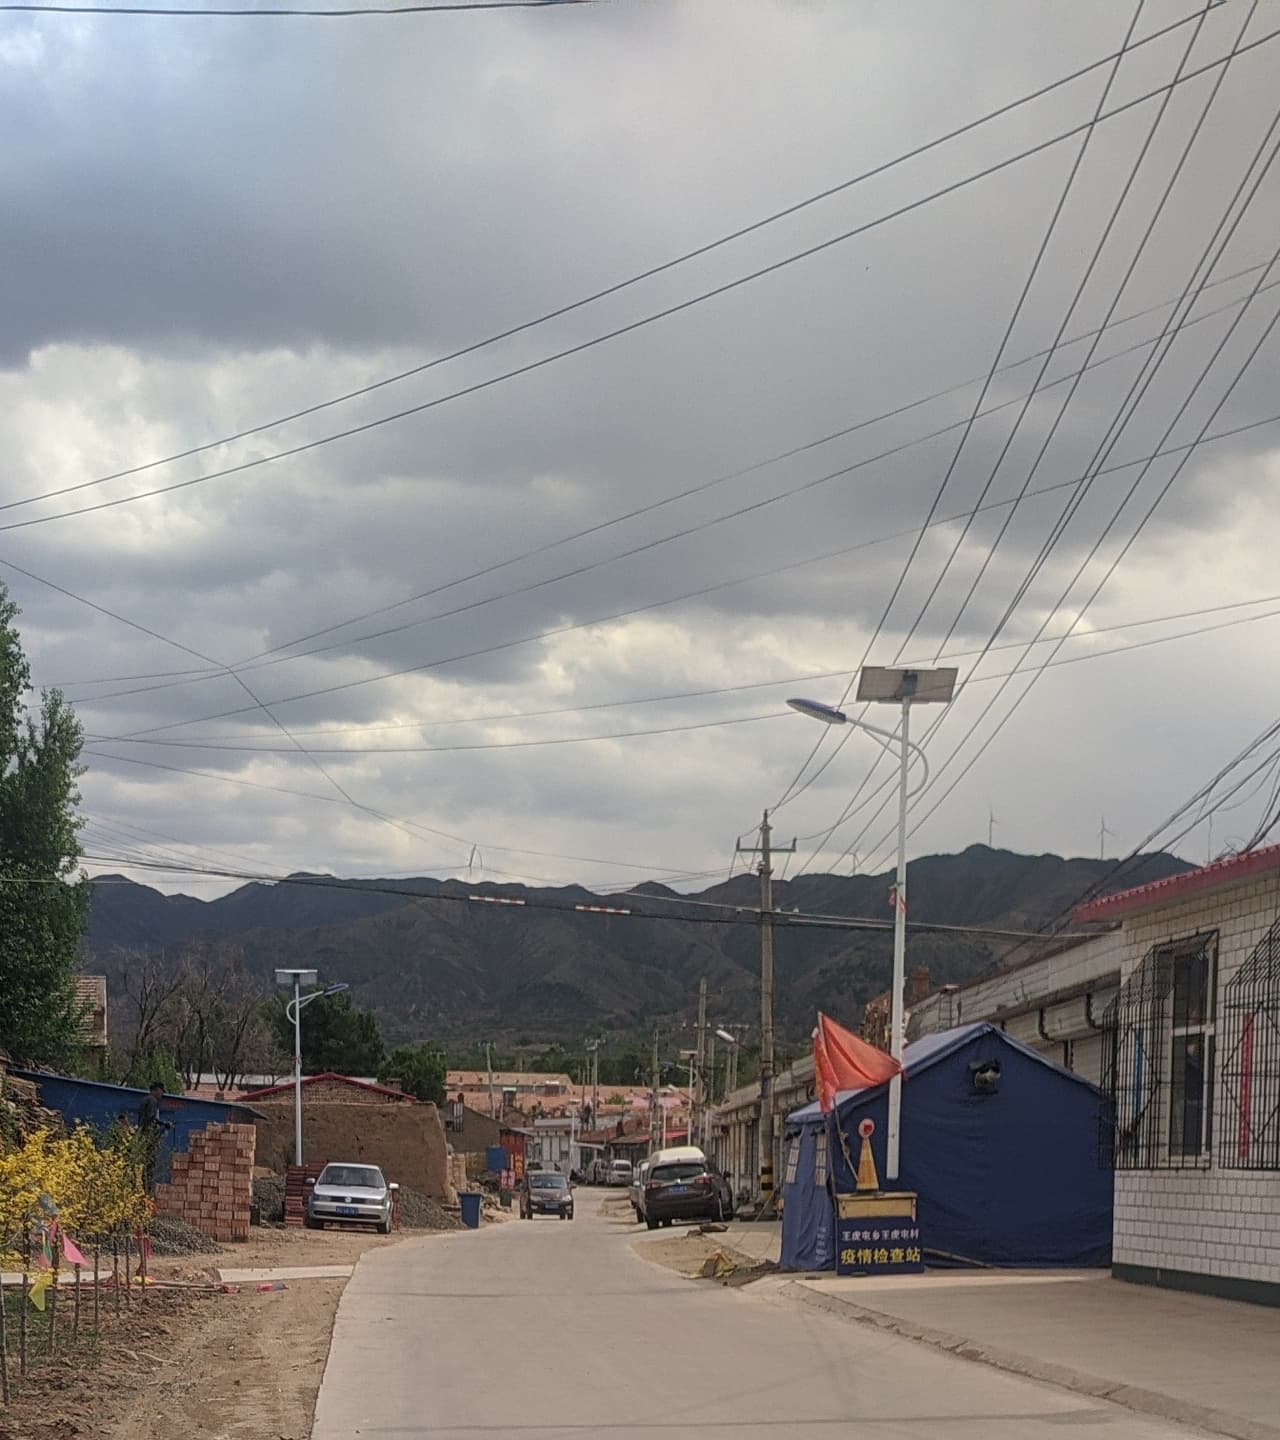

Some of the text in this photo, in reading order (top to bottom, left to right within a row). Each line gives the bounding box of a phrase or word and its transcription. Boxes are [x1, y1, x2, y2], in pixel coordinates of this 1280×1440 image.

[840, 1247, 921, 1264] 疫情检查站
